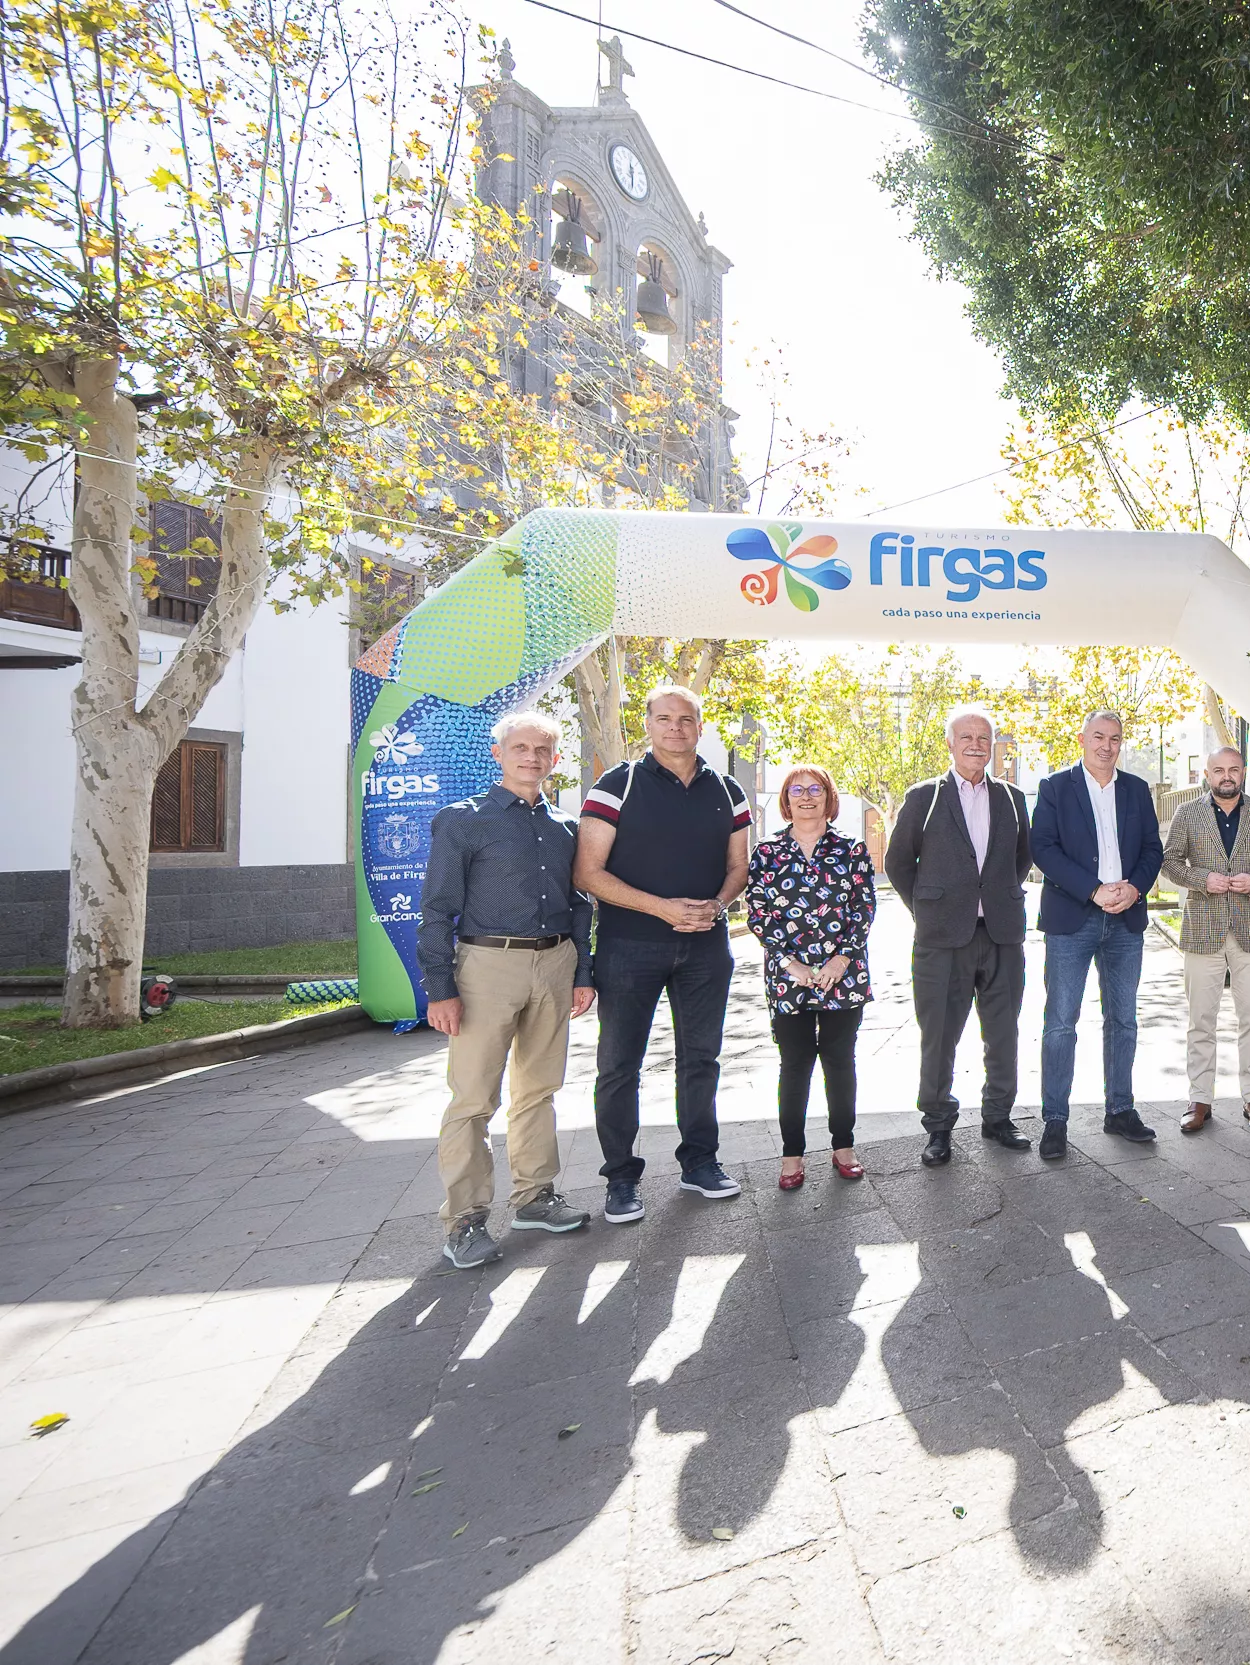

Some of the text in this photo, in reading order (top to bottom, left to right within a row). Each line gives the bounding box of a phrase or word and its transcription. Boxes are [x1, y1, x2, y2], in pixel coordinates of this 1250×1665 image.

[923, 532, 1011, 542] TURISMO
[870, 531, 1048, 603] firgas
[882, 607, 1042, 621] cada paso una experiencia
[361, 770, 440, 800] firgas
[414, 861, 423, 869] de
[370, 870, 427, 881] Villa de Firg
[369, 911, 424, 923] GranCana
